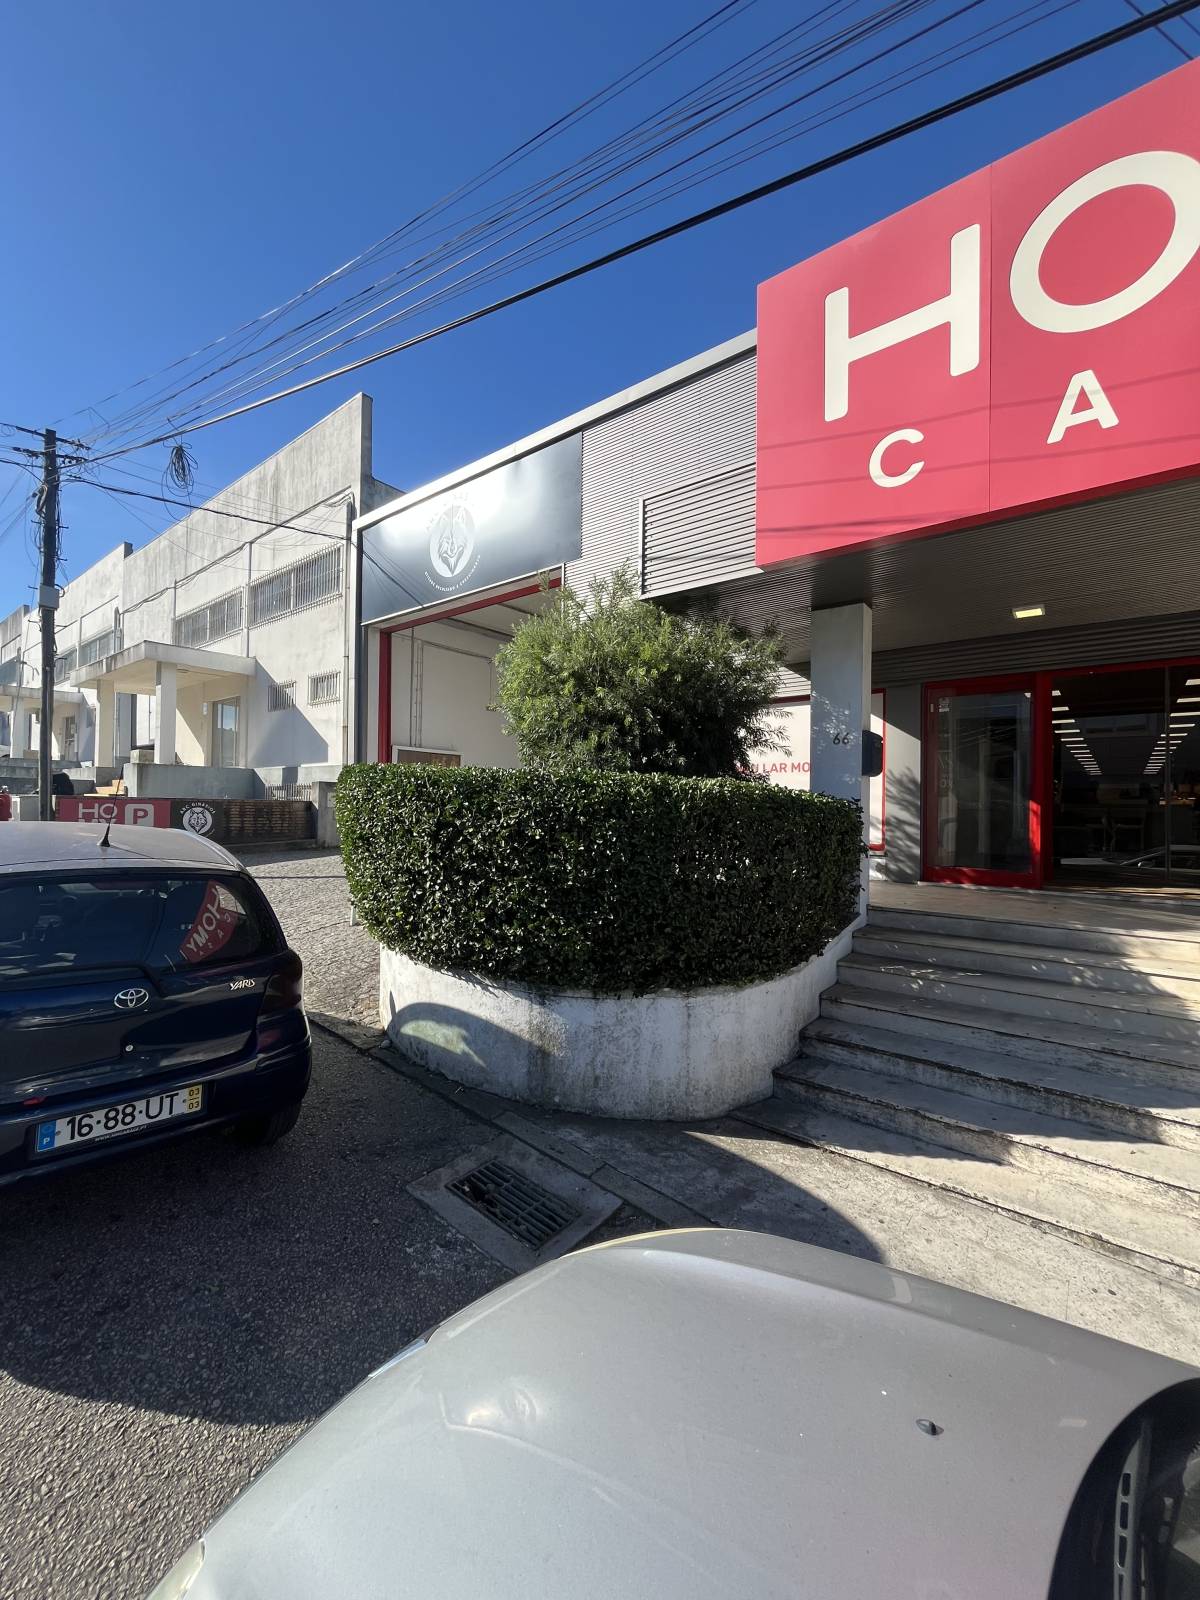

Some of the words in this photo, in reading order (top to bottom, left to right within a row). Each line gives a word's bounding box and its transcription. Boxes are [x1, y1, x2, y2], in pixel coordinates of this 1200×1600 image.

[824, 150, 1200, 422] HO
[832, 733, 850, 746] 66
[762, 762, 788, 774] LAR
[229, 978, 256, 991] YARIS
[188, 1087, 200, 1097] 03
[188, 1100, 200, 1110] 03
[43, 1137, 50, 1145] P
